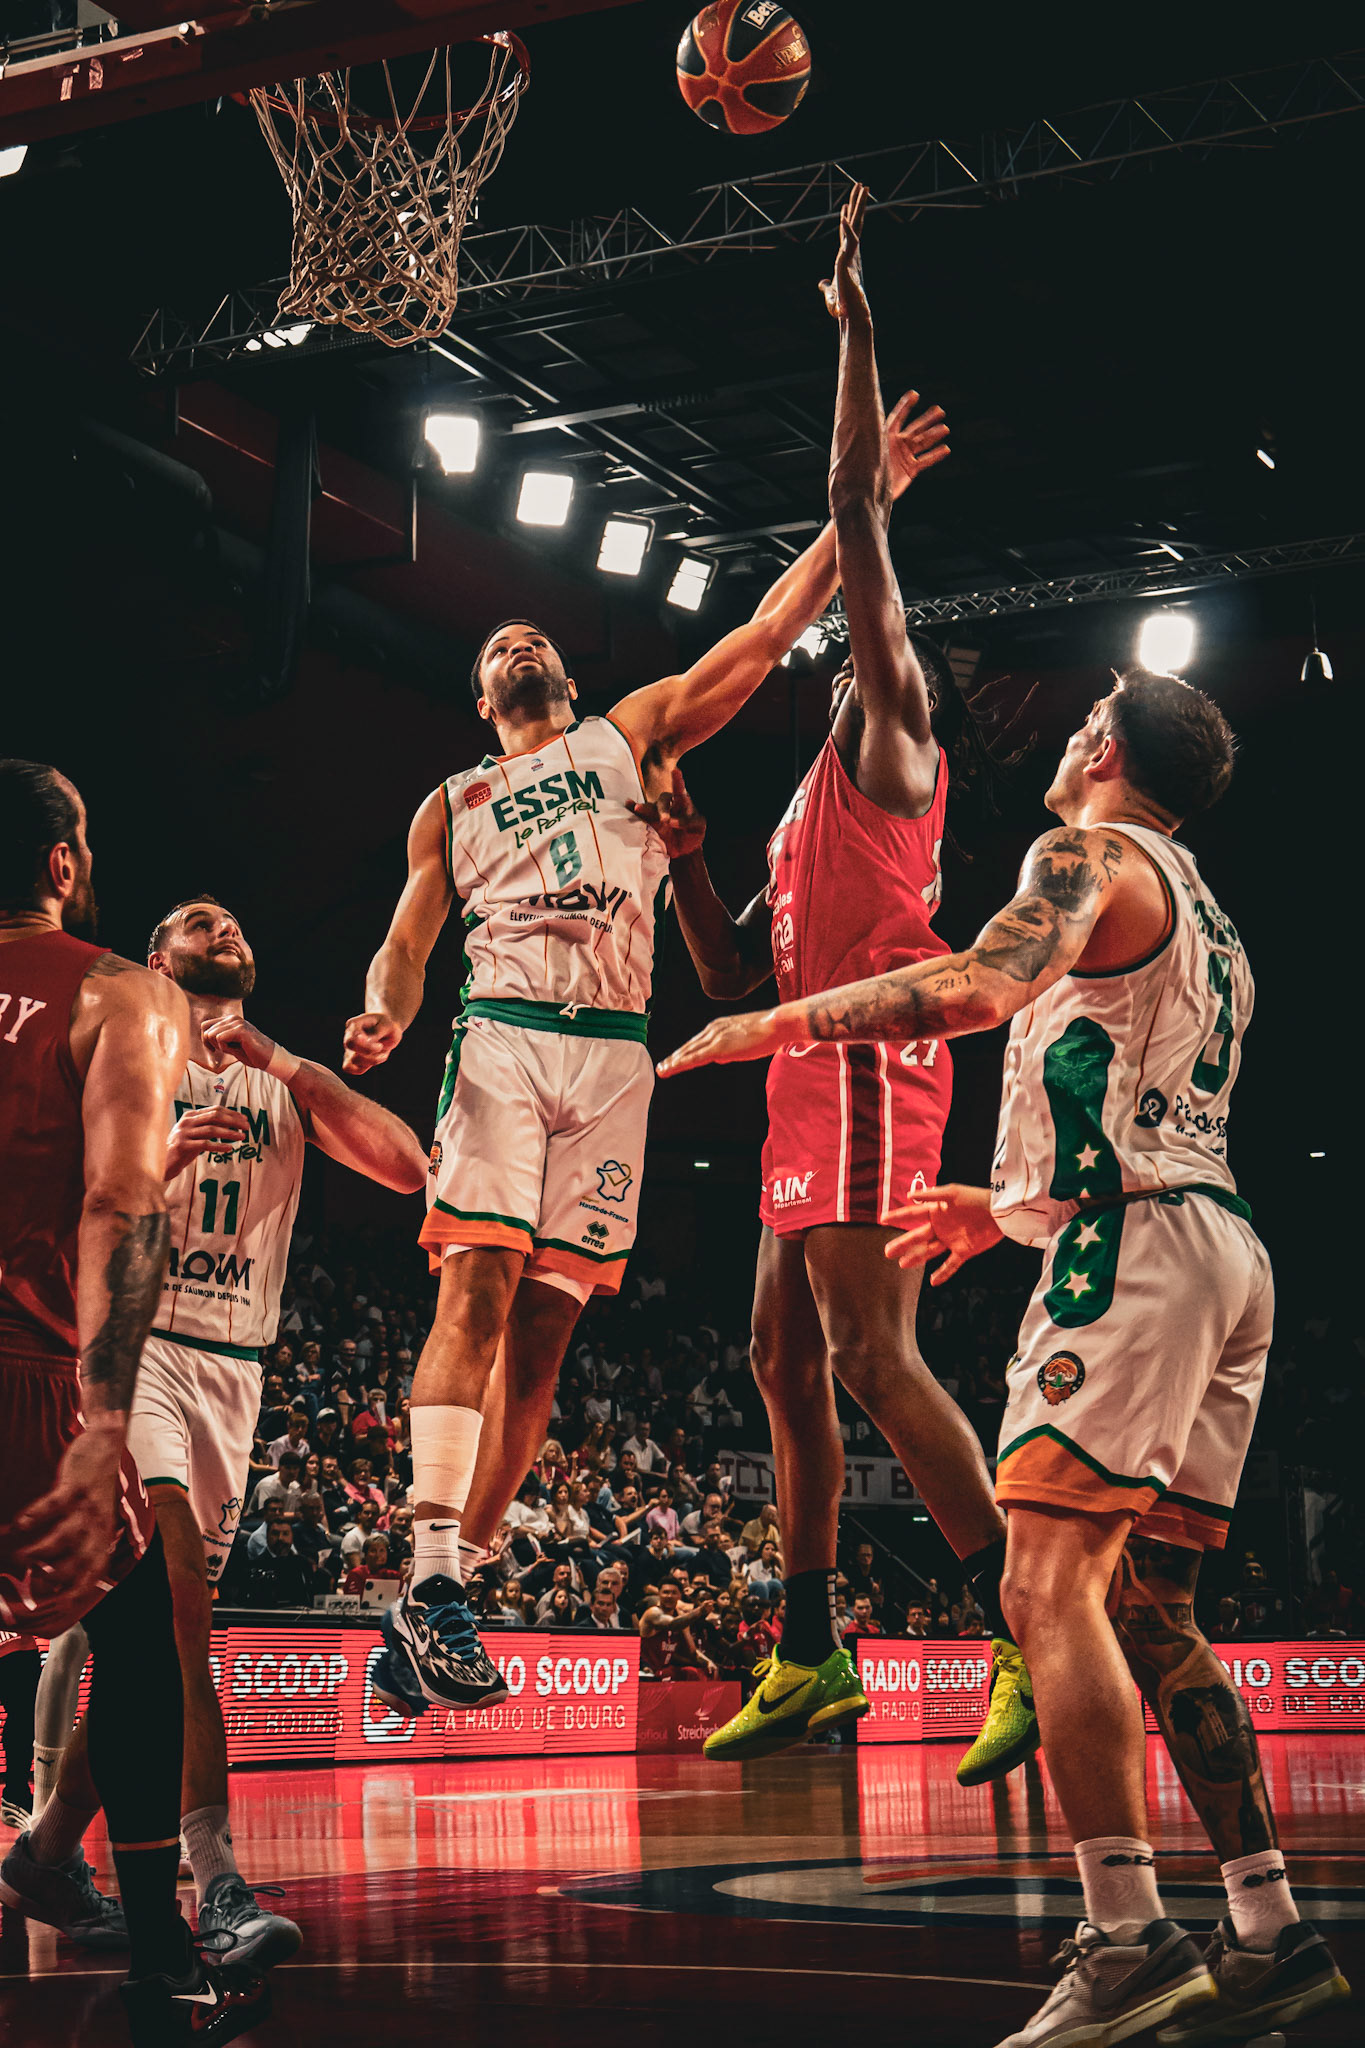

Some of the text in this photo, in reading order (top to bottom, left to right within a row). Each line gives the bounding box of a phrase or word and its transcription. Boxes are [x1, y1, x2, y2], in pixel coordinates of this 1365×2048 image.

[491, 770, 605, 832] ESSM
[549, 830, 582, 889] 8
[899, 1039, 938, 1066] 27
[199, 1178, 241, 1236] 11
[773, 1176, 808, 1203] AIN
[231, 1653, 348, 1699] SCOOP
[535, 1656, 629, 1696] SCOOP
[862, 1658, 988, 1692] RADIO SCOOP
[532, 1704, 556, 1730] DE
[564, 1704, 626, 1730] BOURG
[882, 1701, 920, 1721] RADIO
